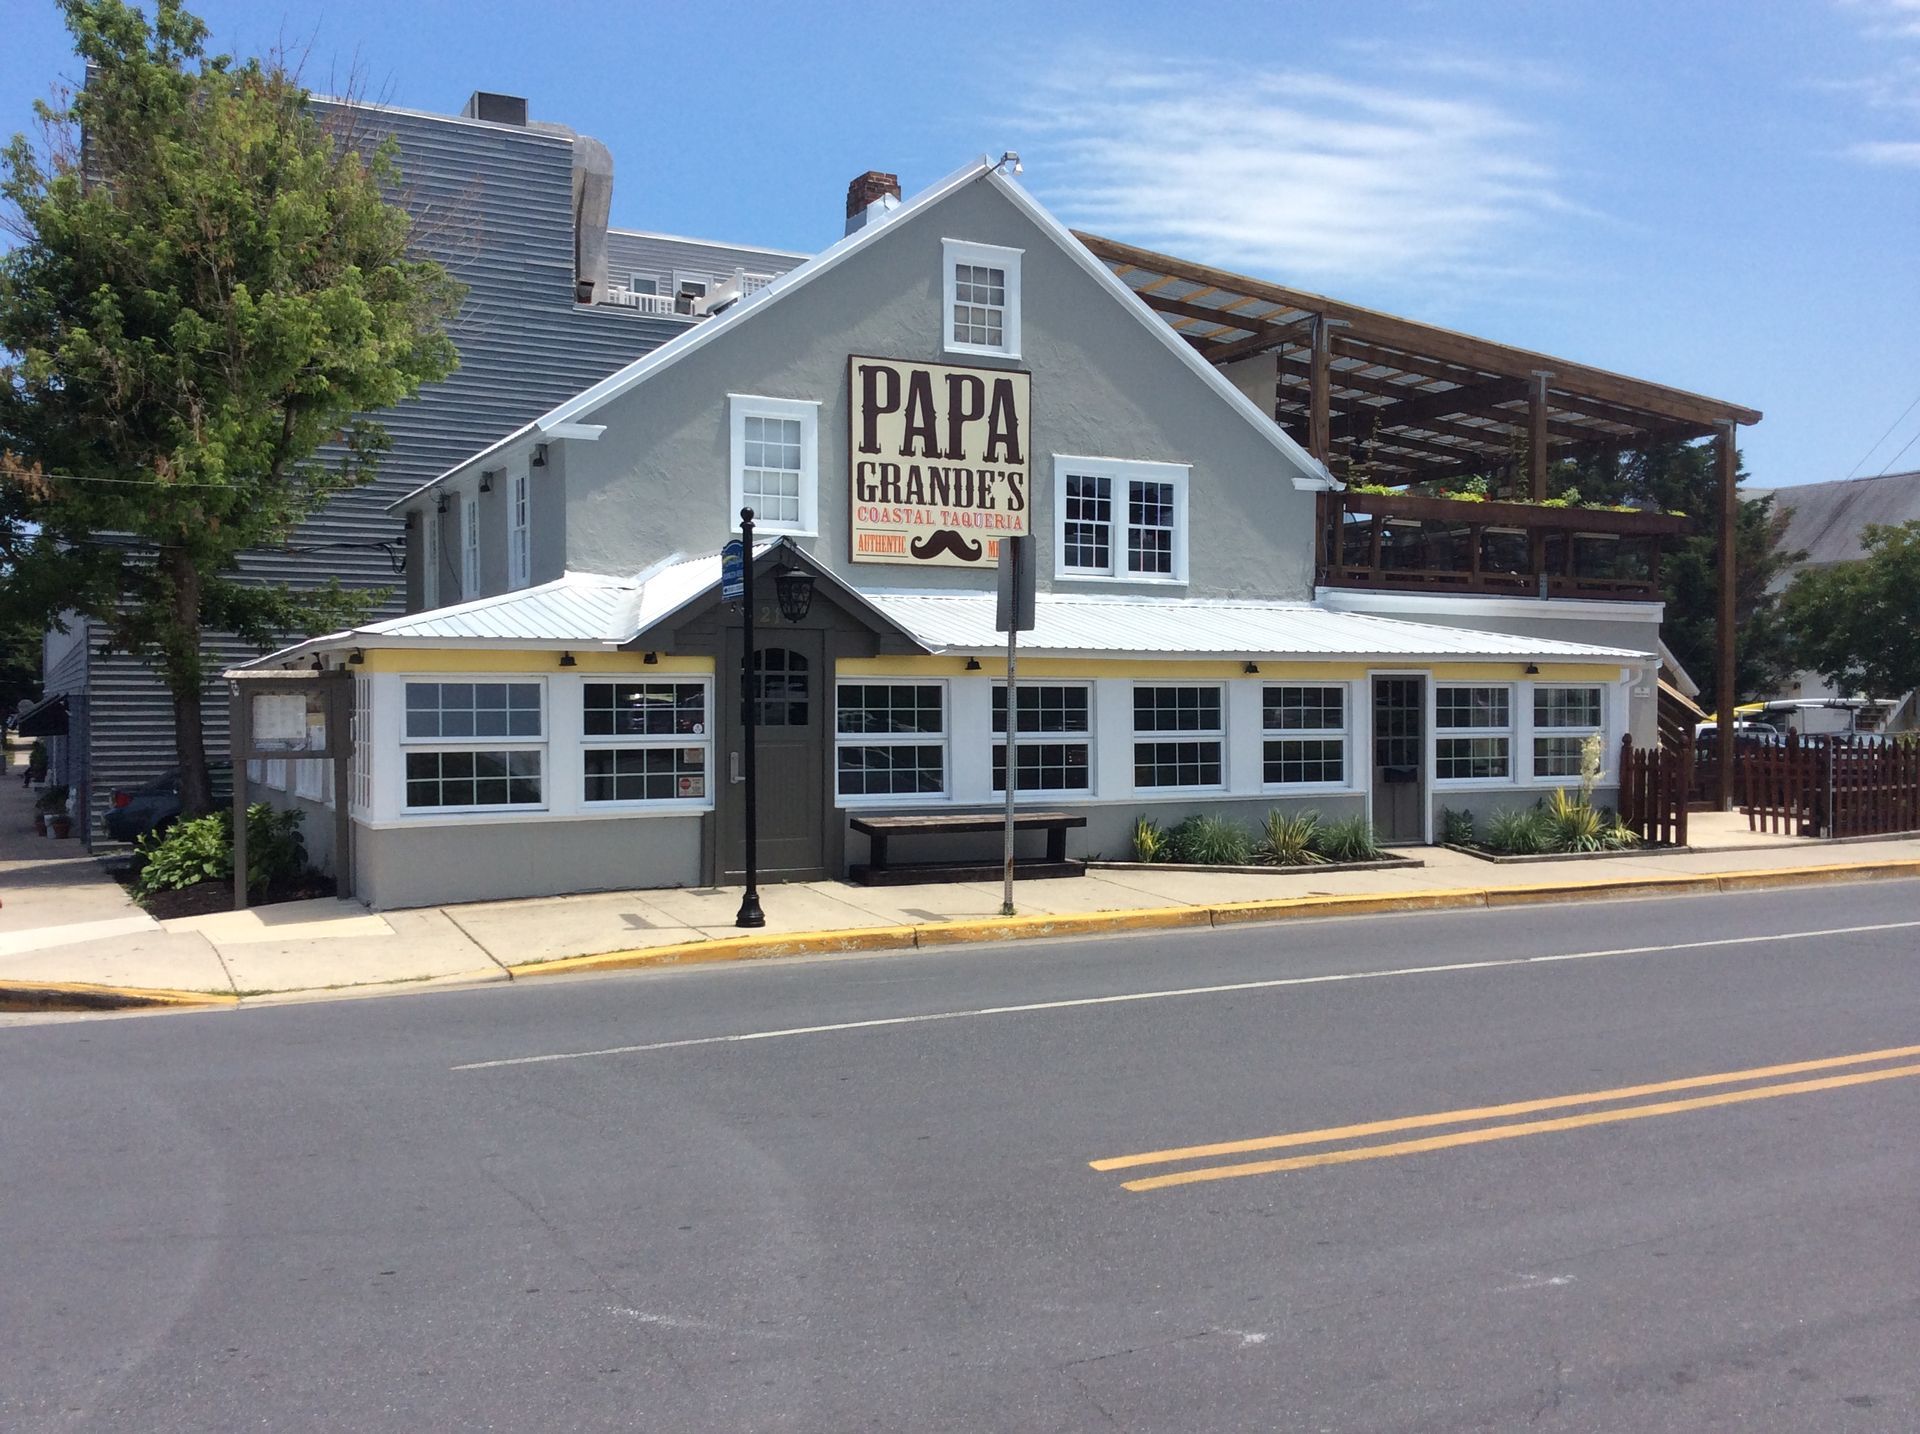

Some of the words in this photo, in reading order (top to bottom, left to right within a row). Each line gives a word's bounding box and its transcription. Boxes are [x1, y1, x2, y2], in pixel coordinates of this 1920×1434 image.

[858, 364, 1025, 465] PAPA
[856, 461, 1025, 511] GRANDE'S
[857, 506, 935, 525] COASTAL
[940, 510, 1023, 530] TAQUERIA
[858, 533, 907, 554] AUTHENTIC
